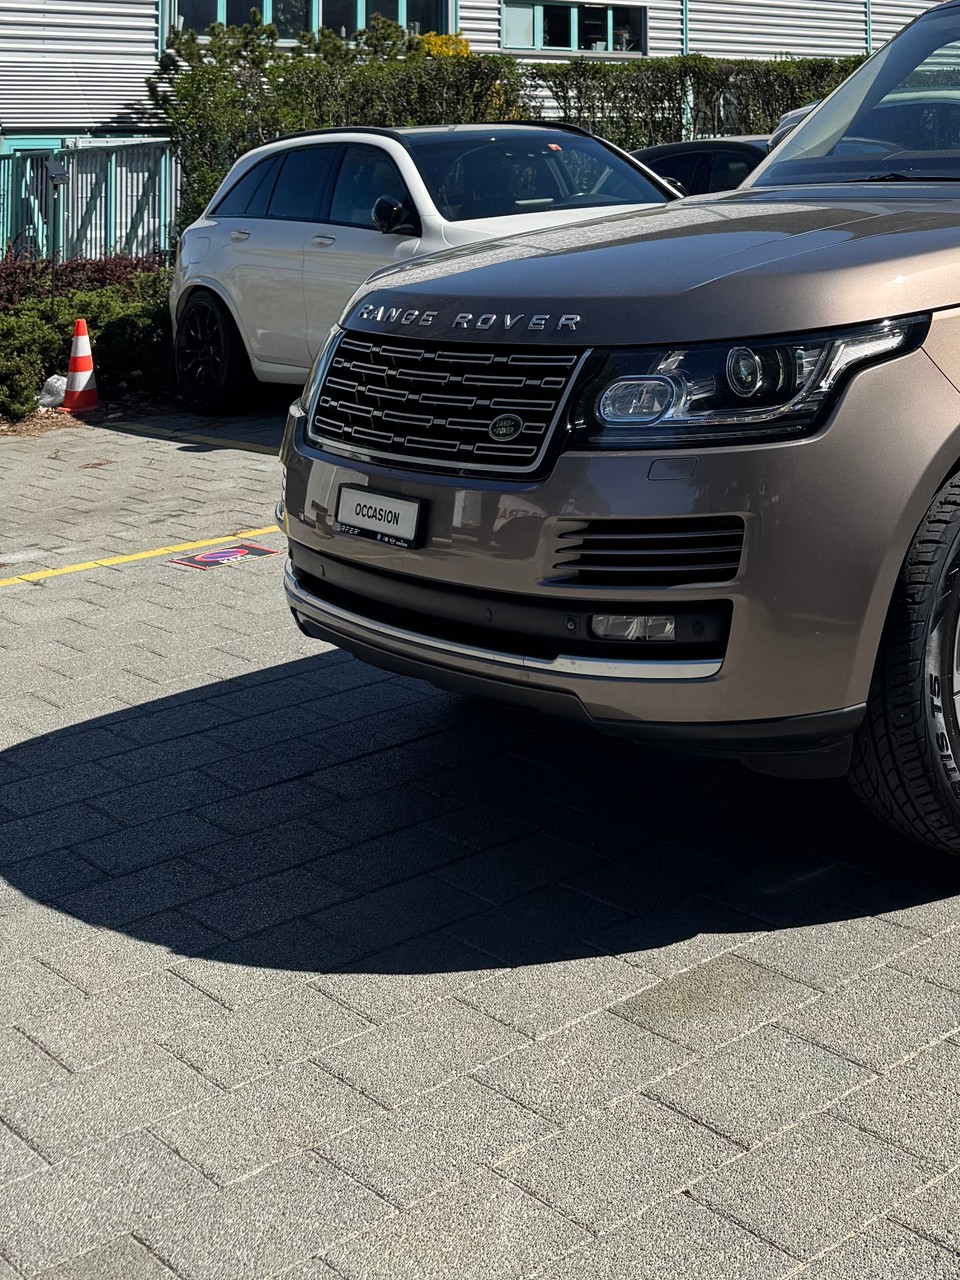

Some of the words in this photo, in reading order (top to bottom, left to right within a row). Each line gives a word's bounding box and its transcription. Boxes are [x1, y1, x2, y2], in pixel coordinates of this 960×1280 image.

[357, 303, 438, 326] RANGE
[452, 313, 581, 331] ROVER
[495, 419, 512, 427] LAND
[495, 426, 515, 435] ROVER
[354, 502, 401, 526] OCCASION
[929, 673, 943, 719] T5
